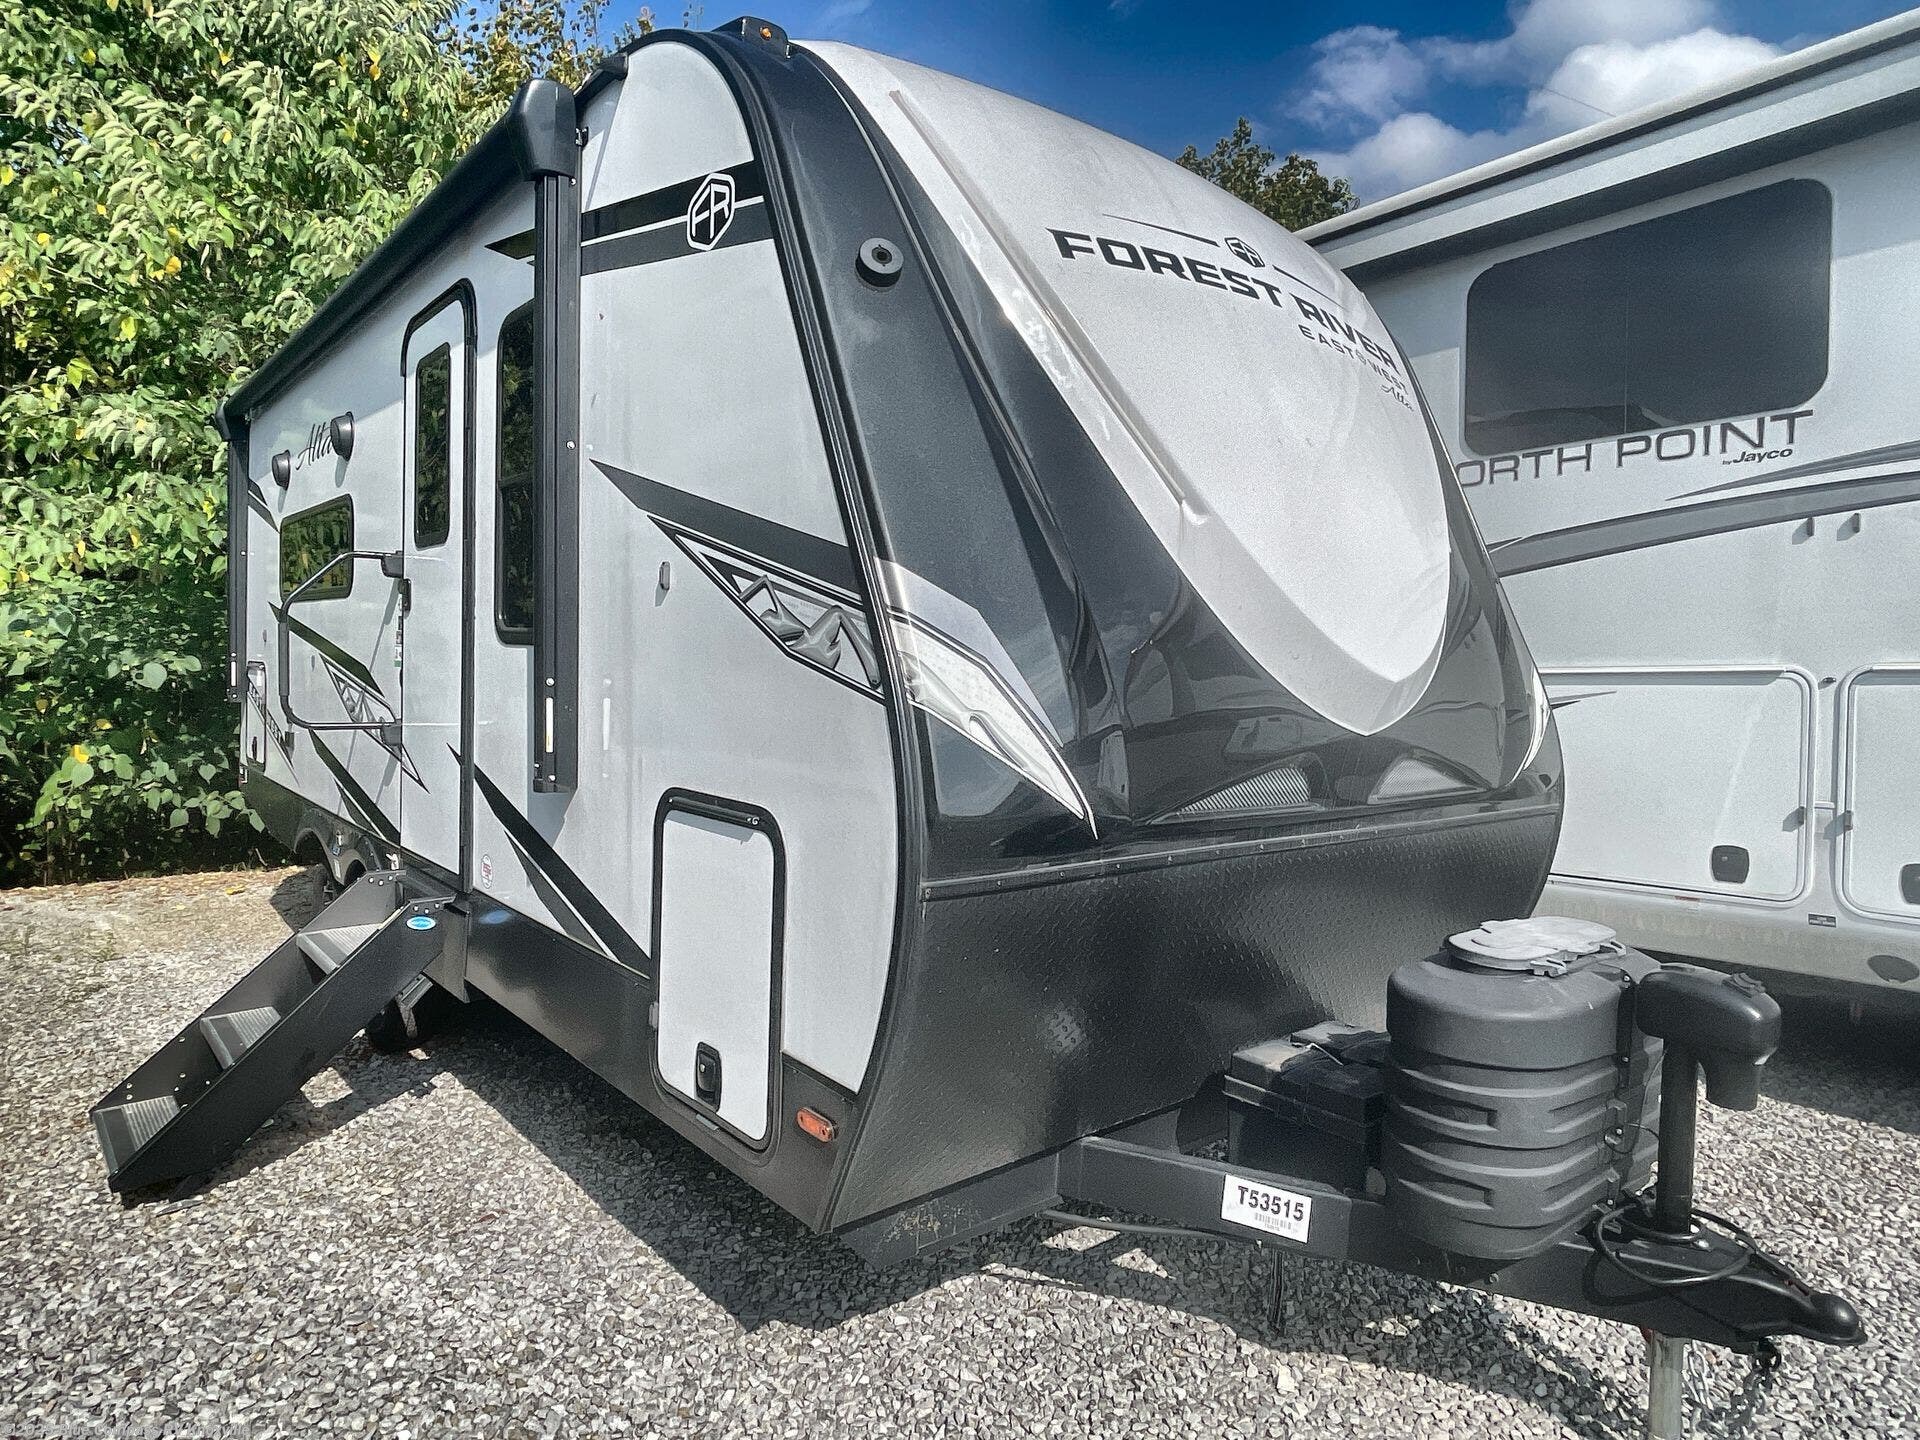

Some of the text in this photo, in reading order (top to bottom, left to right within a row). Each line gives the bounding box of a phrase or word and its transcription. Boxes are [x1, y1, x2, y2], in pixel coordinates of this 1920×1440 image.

[1046, 228, 1400, 377] FOREST RIVER
[1298, 324, 1354, 359] EAST
[1615, 409, 1813, 468] POINT
[1732, 448, 1793, 464] Jayco
[1238, 1185, 1304, 1222] T53515
